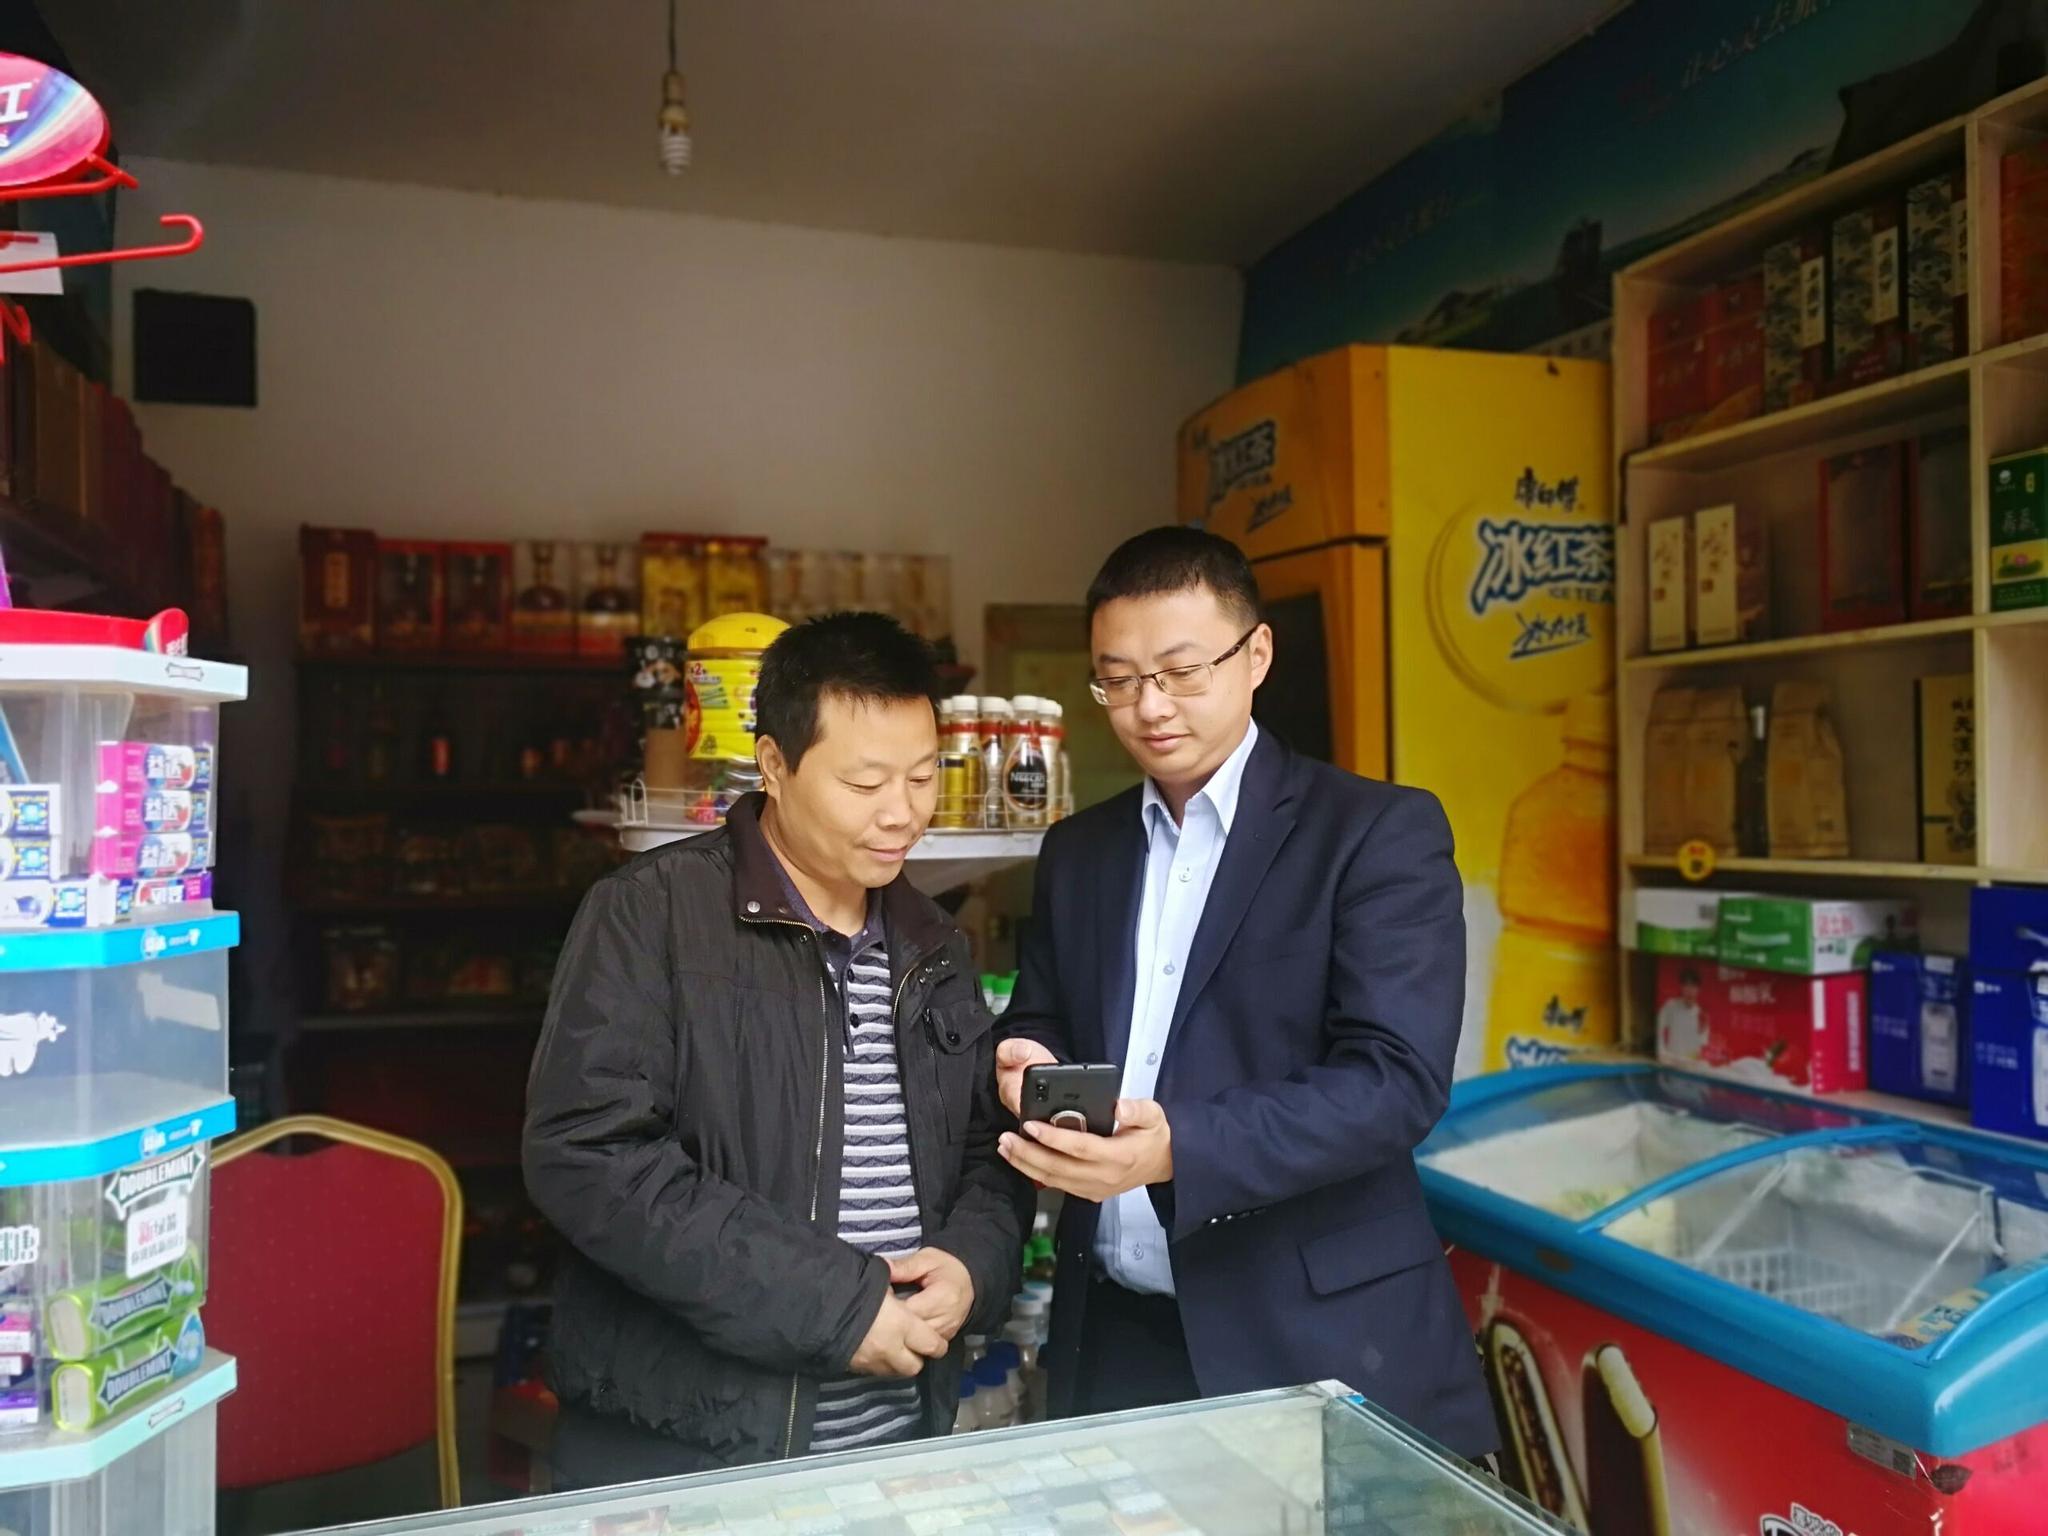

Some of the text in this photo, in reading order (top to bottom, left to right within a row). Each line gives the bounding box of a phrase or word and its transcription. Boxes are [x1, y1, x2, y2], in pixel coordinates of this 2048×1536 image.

[1471, 519, 1614, 615] 冰红茶
[119, 1150, 194, 1201] DOUBLEMINT
